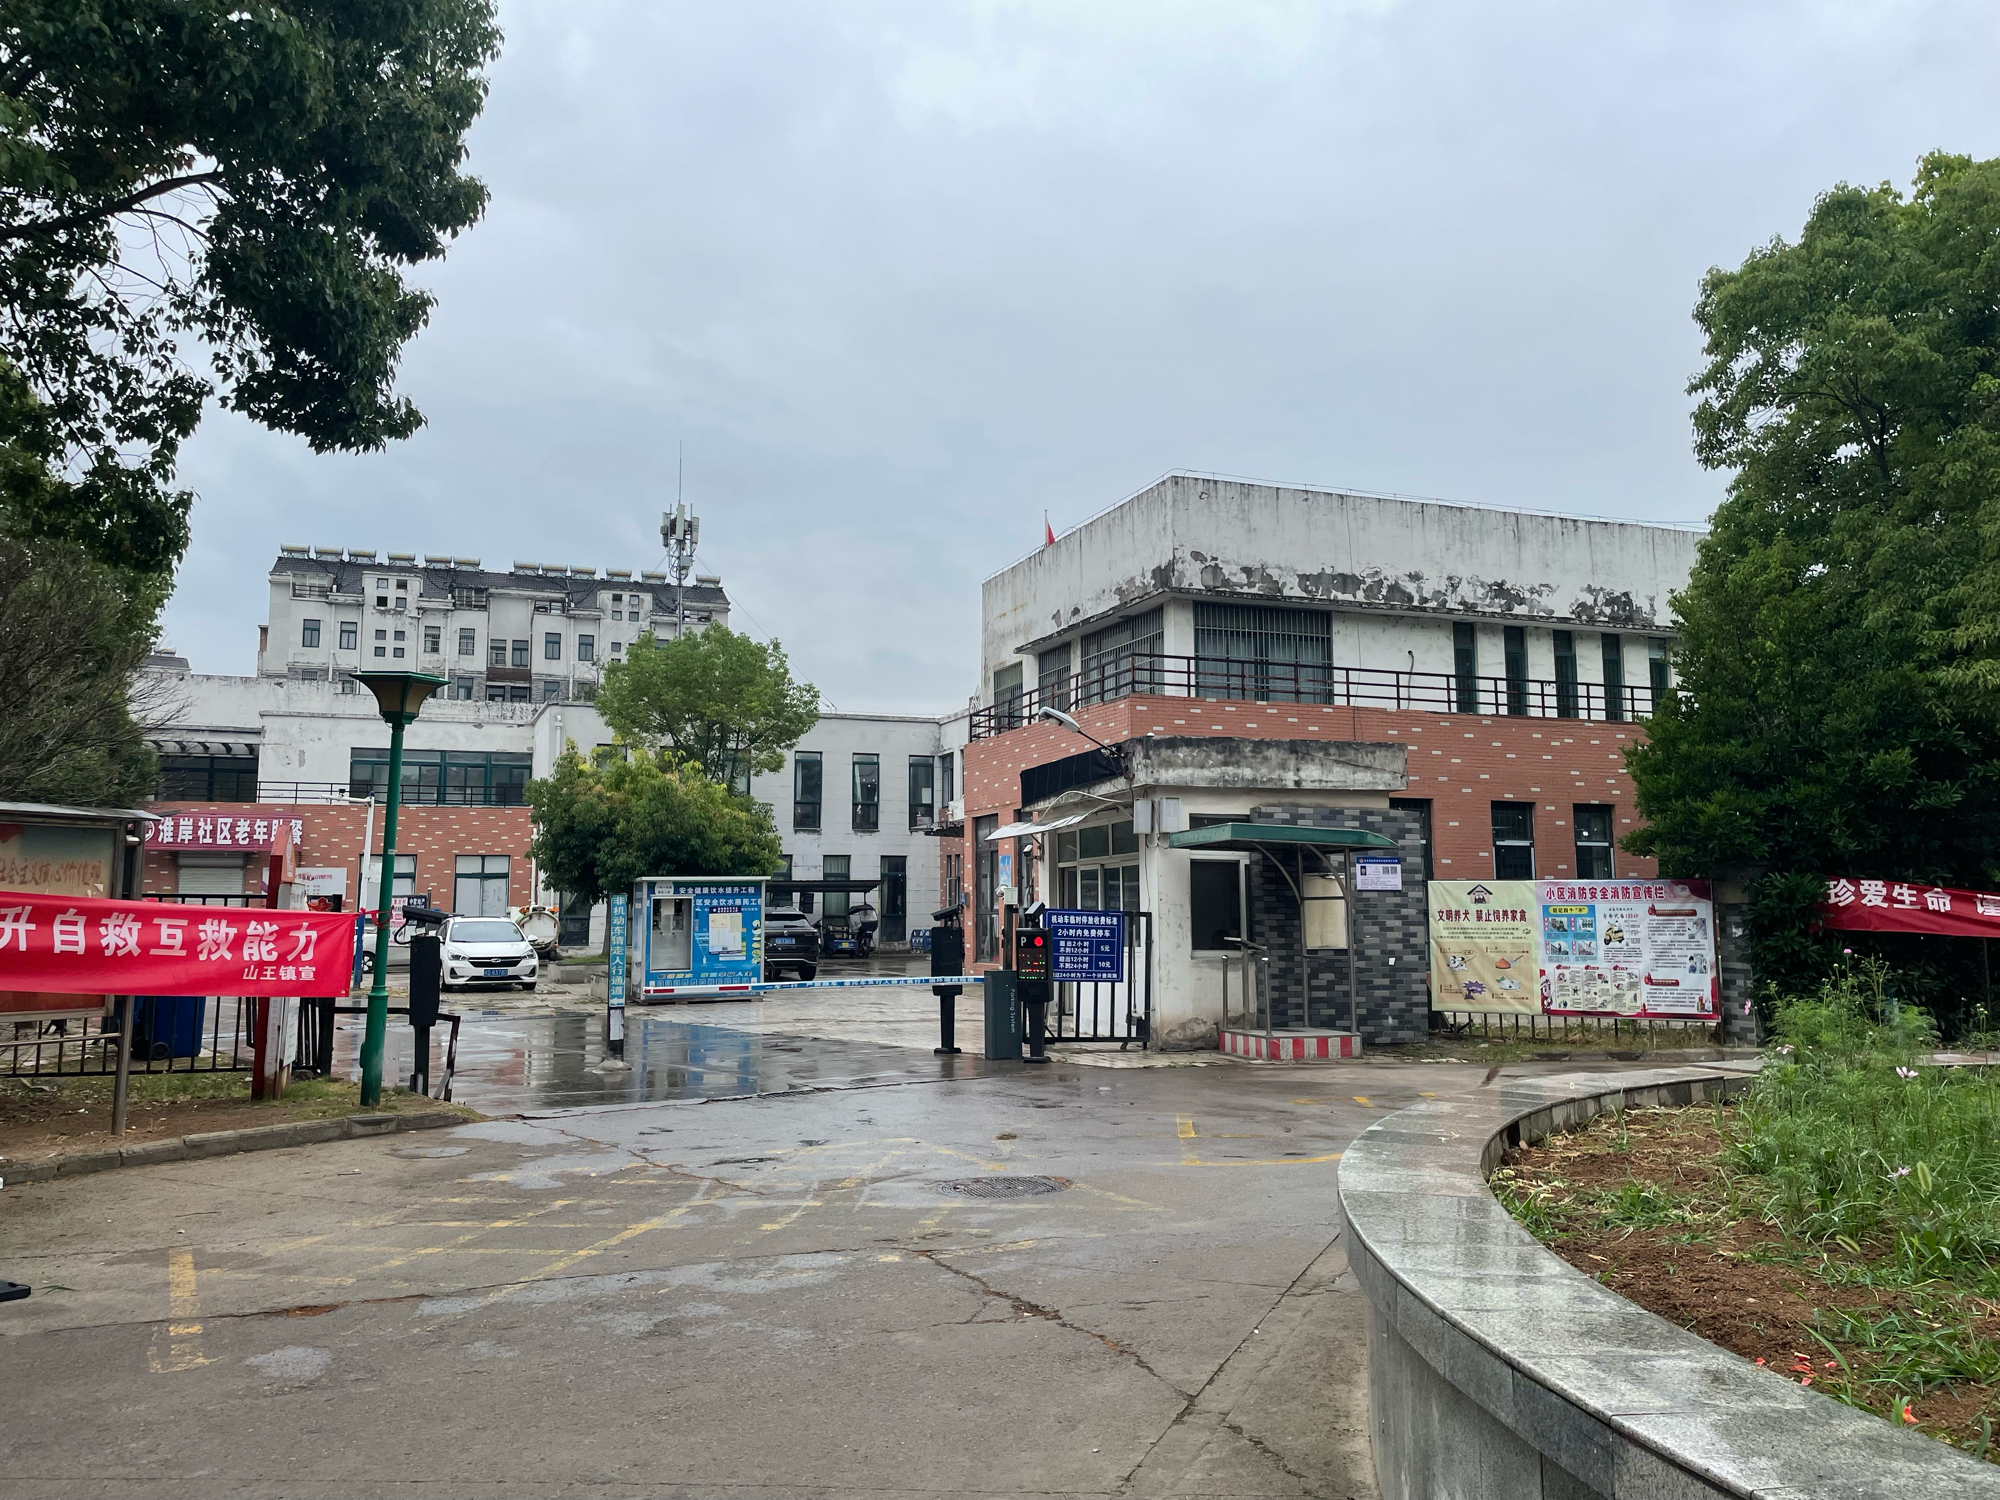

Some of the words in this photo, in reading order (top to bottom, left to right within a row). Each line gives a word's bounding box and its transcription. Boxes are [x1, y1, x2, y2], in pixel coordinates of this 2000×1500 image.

[1546, 886, 1665, 900] 小区消防安全消防宣传栏
[1826, 878, 1952, 912] 珍爱生命
[1051, 915, 1118, 925] 机动车临时停放收费标准
[1437, 909, 1470, 922] 文明养犬
[1476, 909, 1527, 922] 禁止饲养家禽
[0, 905, 318, 963] 升自救互救能力
[1057, 928, 1111, 937] 2小时内免费停车
[611, 896, 626, 995] 非机动车请走人行通道
[242, 965, 316, 981] 山王镇宣
